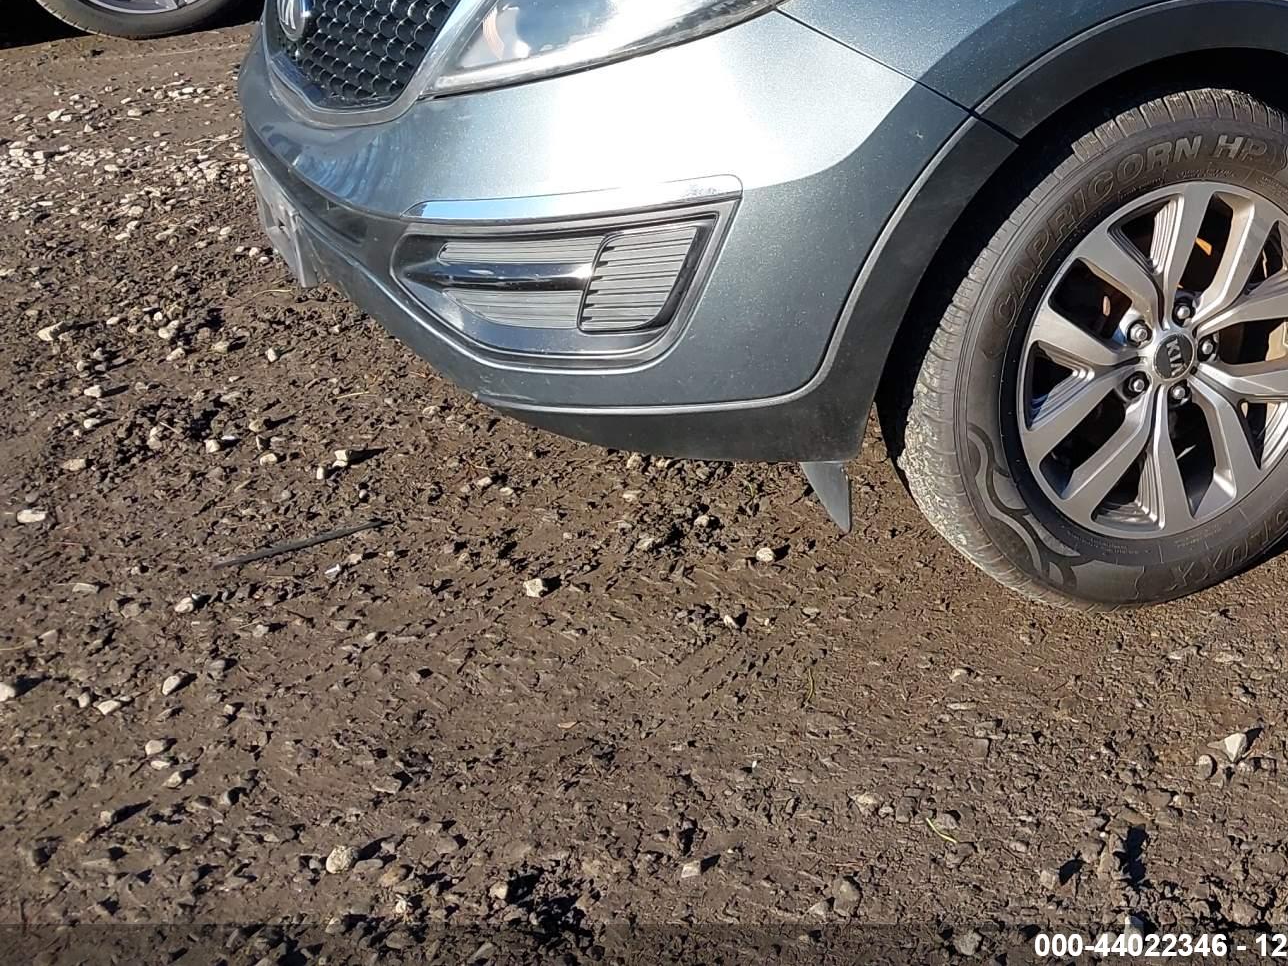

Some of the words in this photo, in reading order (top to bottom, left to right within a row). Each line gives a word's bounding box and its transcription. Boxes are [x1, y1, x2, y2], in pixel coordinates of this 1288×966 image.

[992, 135, 1203, 327] CAPRICORN
[1210, 134, 1268, 164] HP
[1166, 337, 1188, 376] KIA
